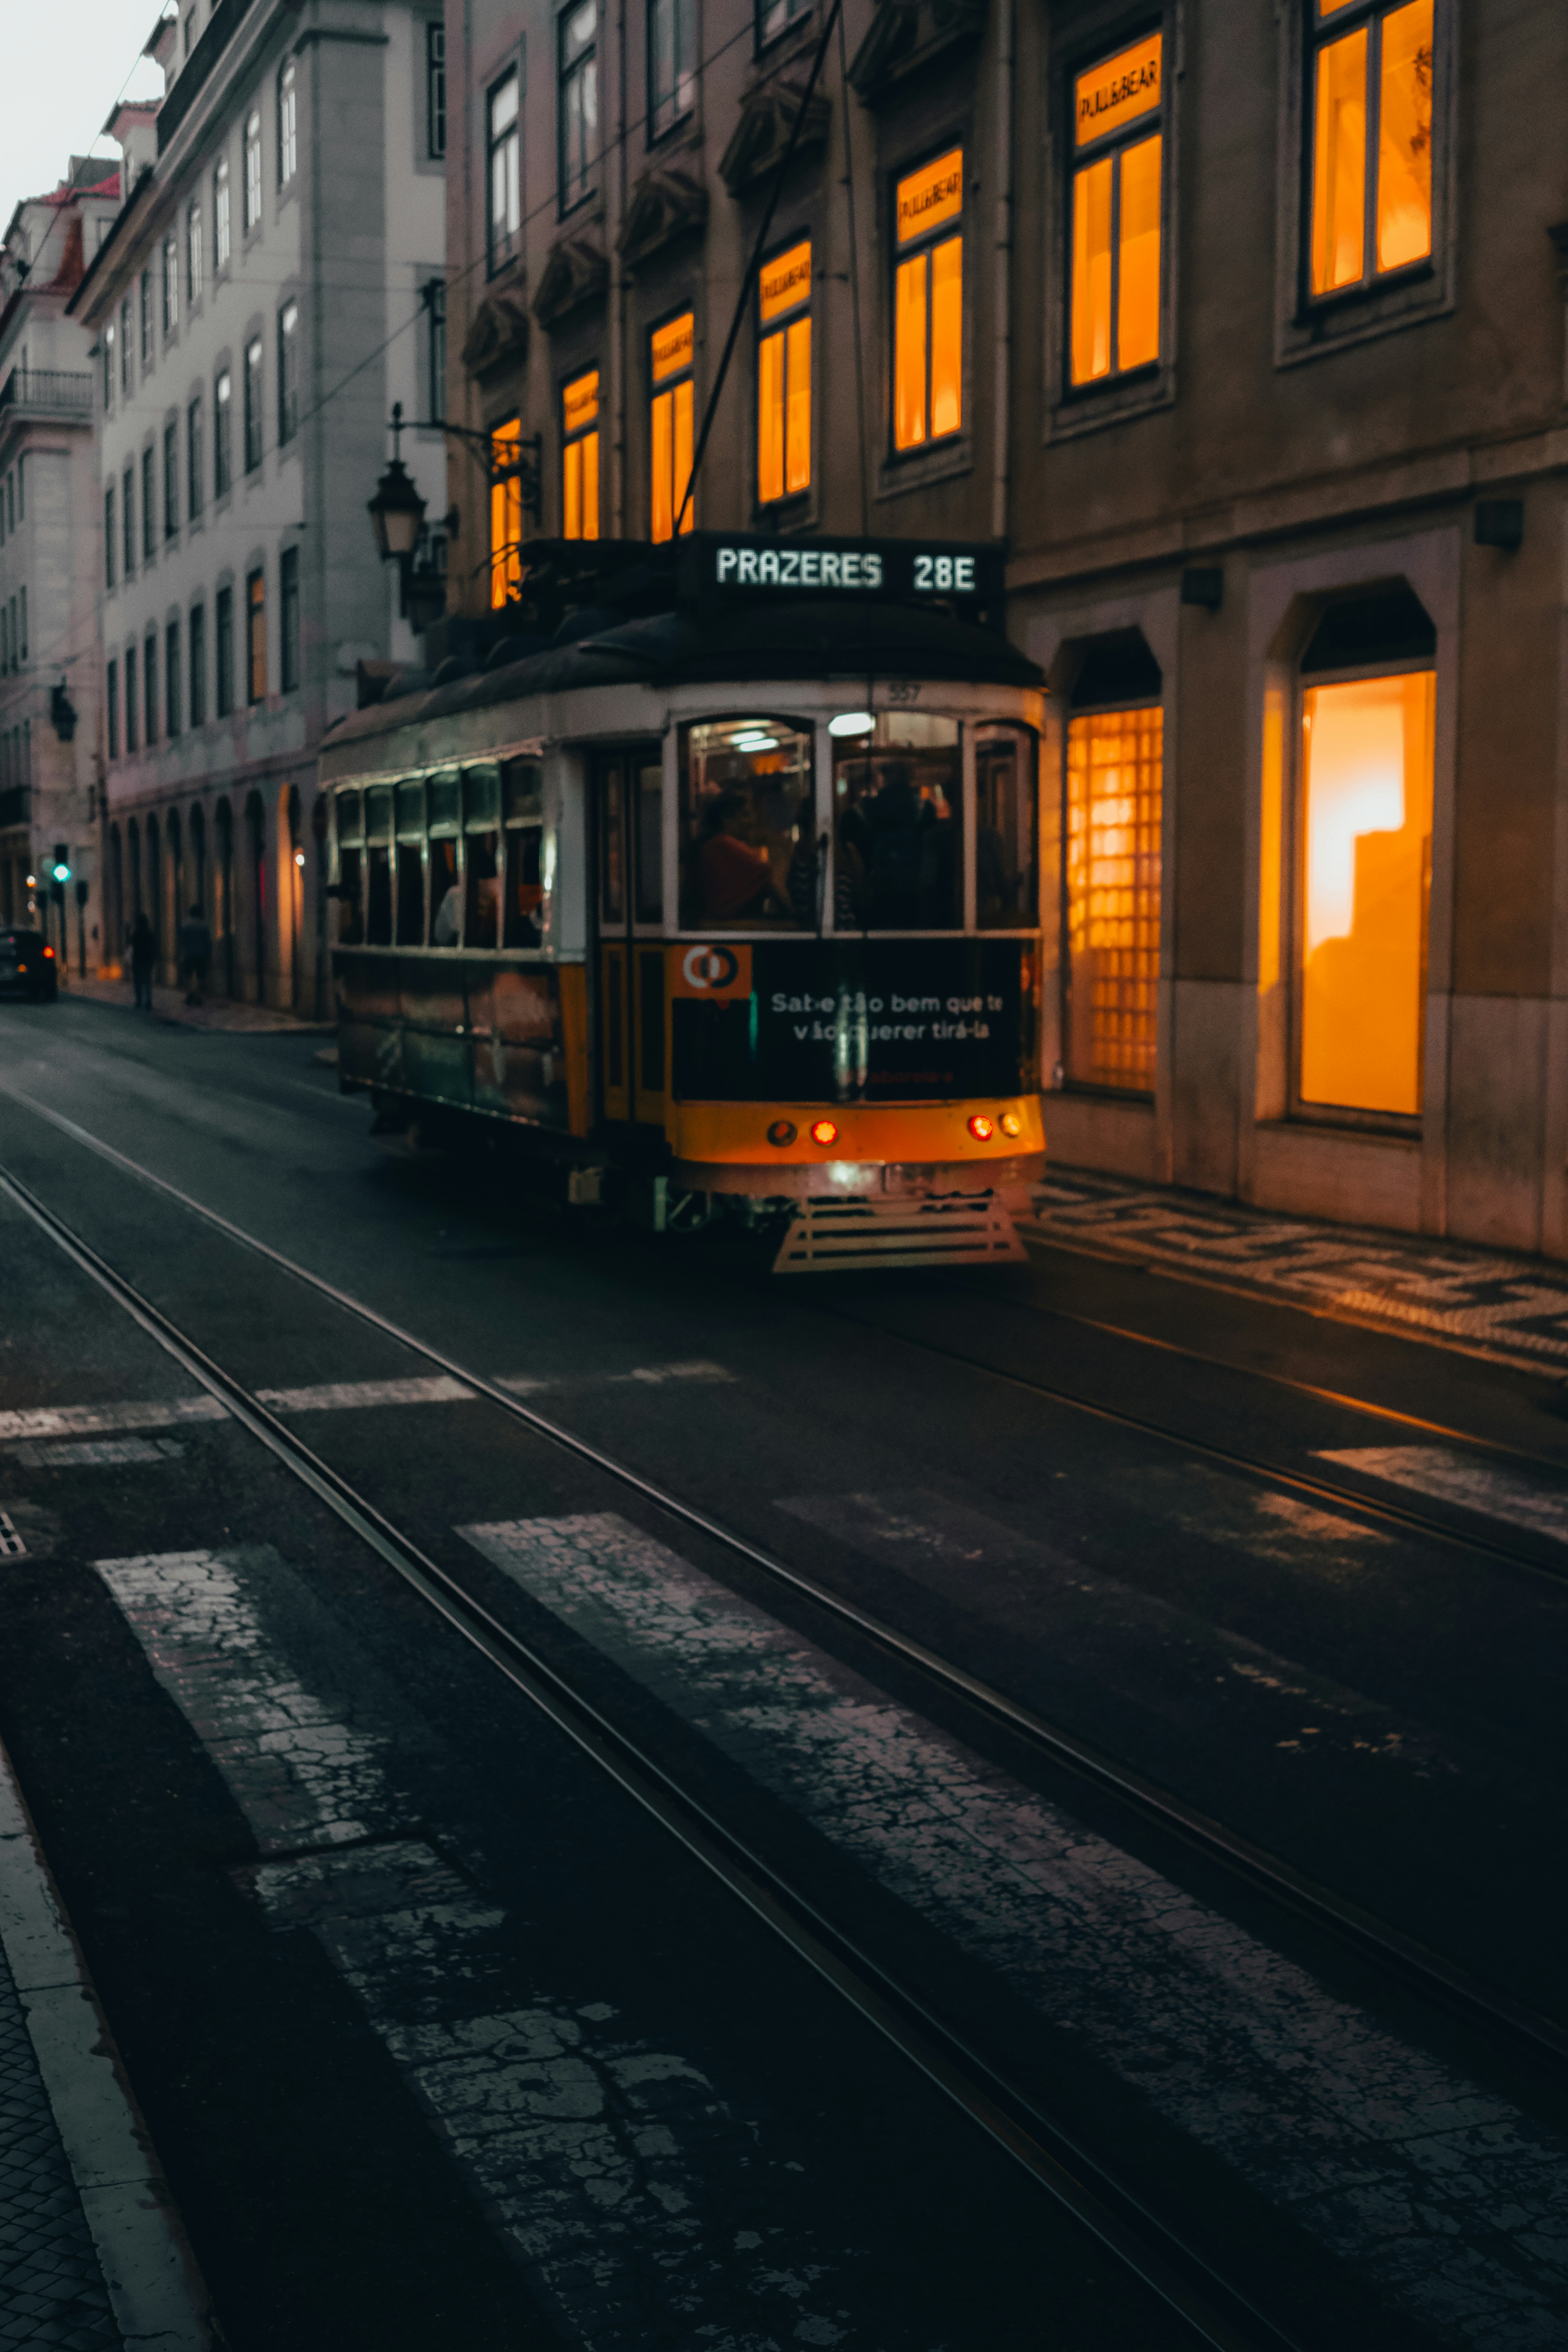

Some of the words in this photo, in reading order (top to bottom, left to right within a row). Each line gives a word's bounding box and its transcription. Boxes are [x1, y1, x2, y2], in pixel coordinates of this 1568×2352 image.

[1079, 60, 1158, 124] PULL&BEAR
[717, 548, 882, 588] PRAZERES
[913, 554, 975, 591] 28E
[891, 993, 940, 1012] bem
[946, 996, 983, 1015] que
